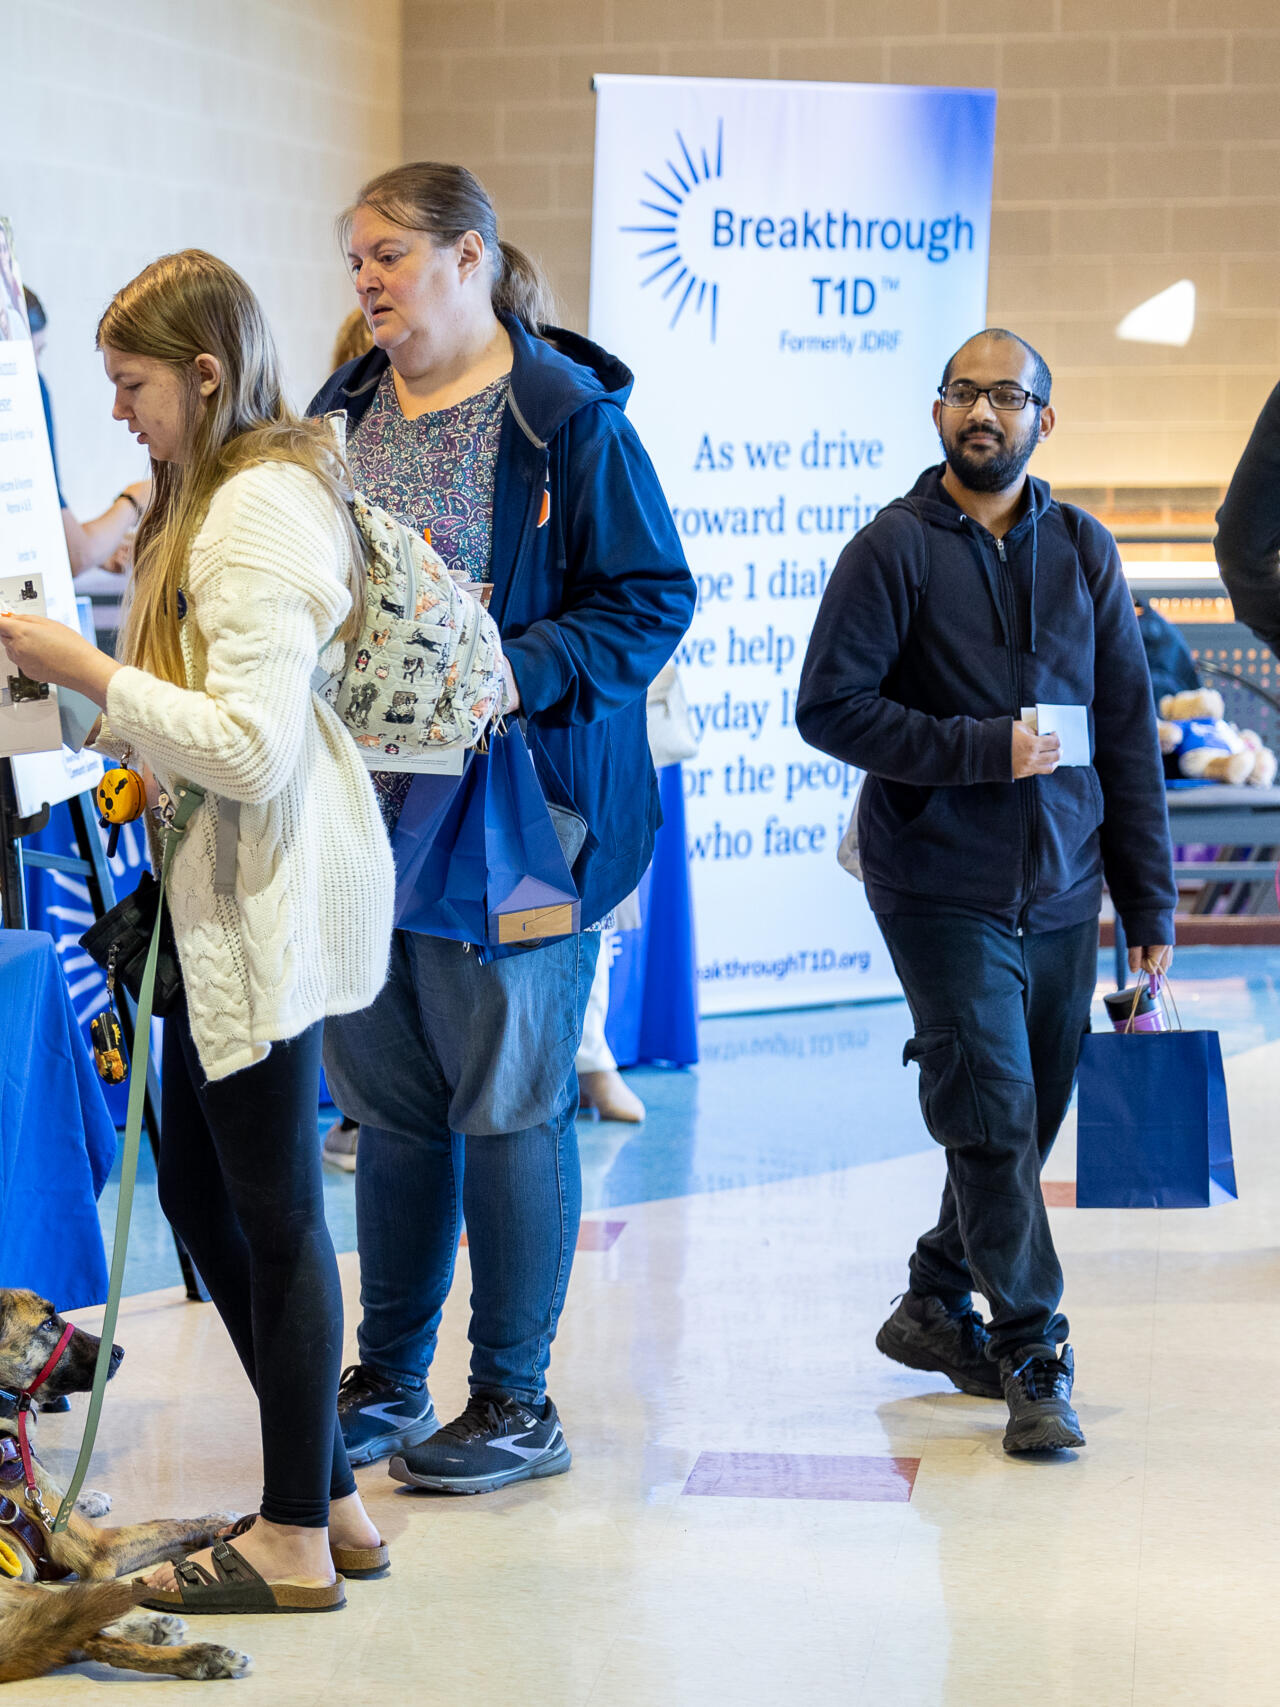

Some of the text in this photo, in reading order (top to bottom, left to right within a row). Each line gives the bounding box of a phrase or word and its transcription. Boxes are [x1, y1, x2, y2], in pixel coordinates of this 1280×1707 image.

[712, 208, 974, 263] Breakthrough
[811, 277, 877, 316] T1D
[779, 329, 903, 356] Formerly JDRF
[694, 429, 884, 471] As we drive
[746, 562, 758, 600] 1
[727, 624, 796, 675] help
[683, 753, 862, 802] or the peop
[765, 814, 826, 857] face
